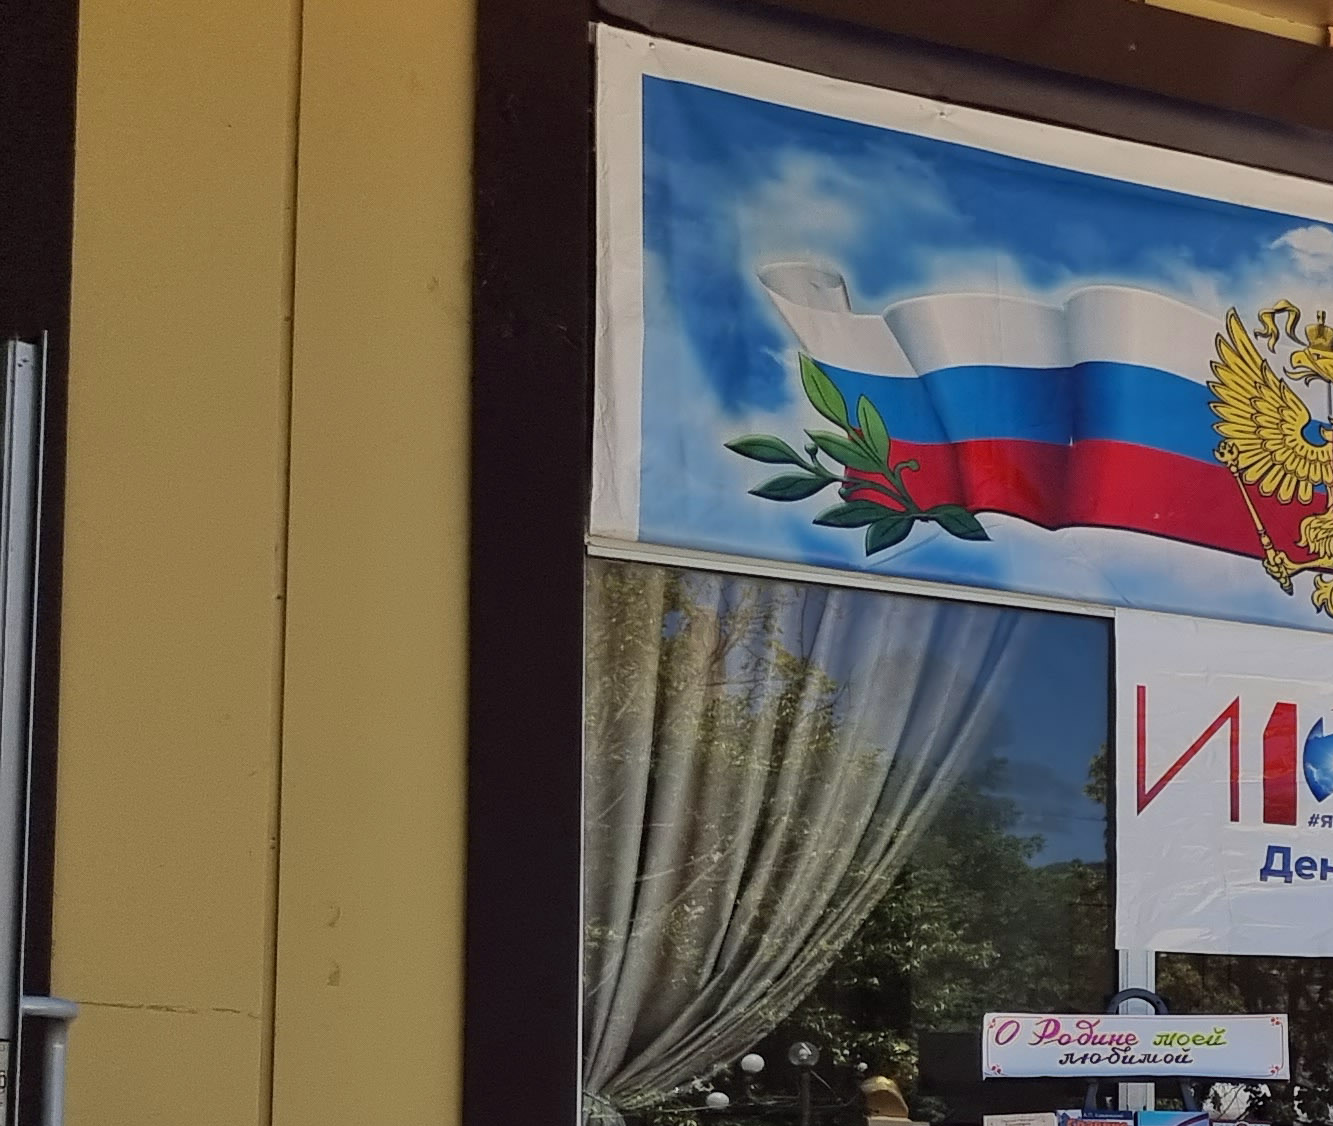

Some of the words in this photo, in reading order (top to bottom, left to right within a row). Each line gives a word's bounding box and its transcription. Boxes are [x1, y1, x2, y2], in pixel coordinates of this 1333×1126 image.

[994, 1020, 1020, 1046] О
[1028, 1018, 1139, 1046] Родине
[1152, 1027, 1228, 1047] моей
[1059, 1046, 1194, 1065] любимой
